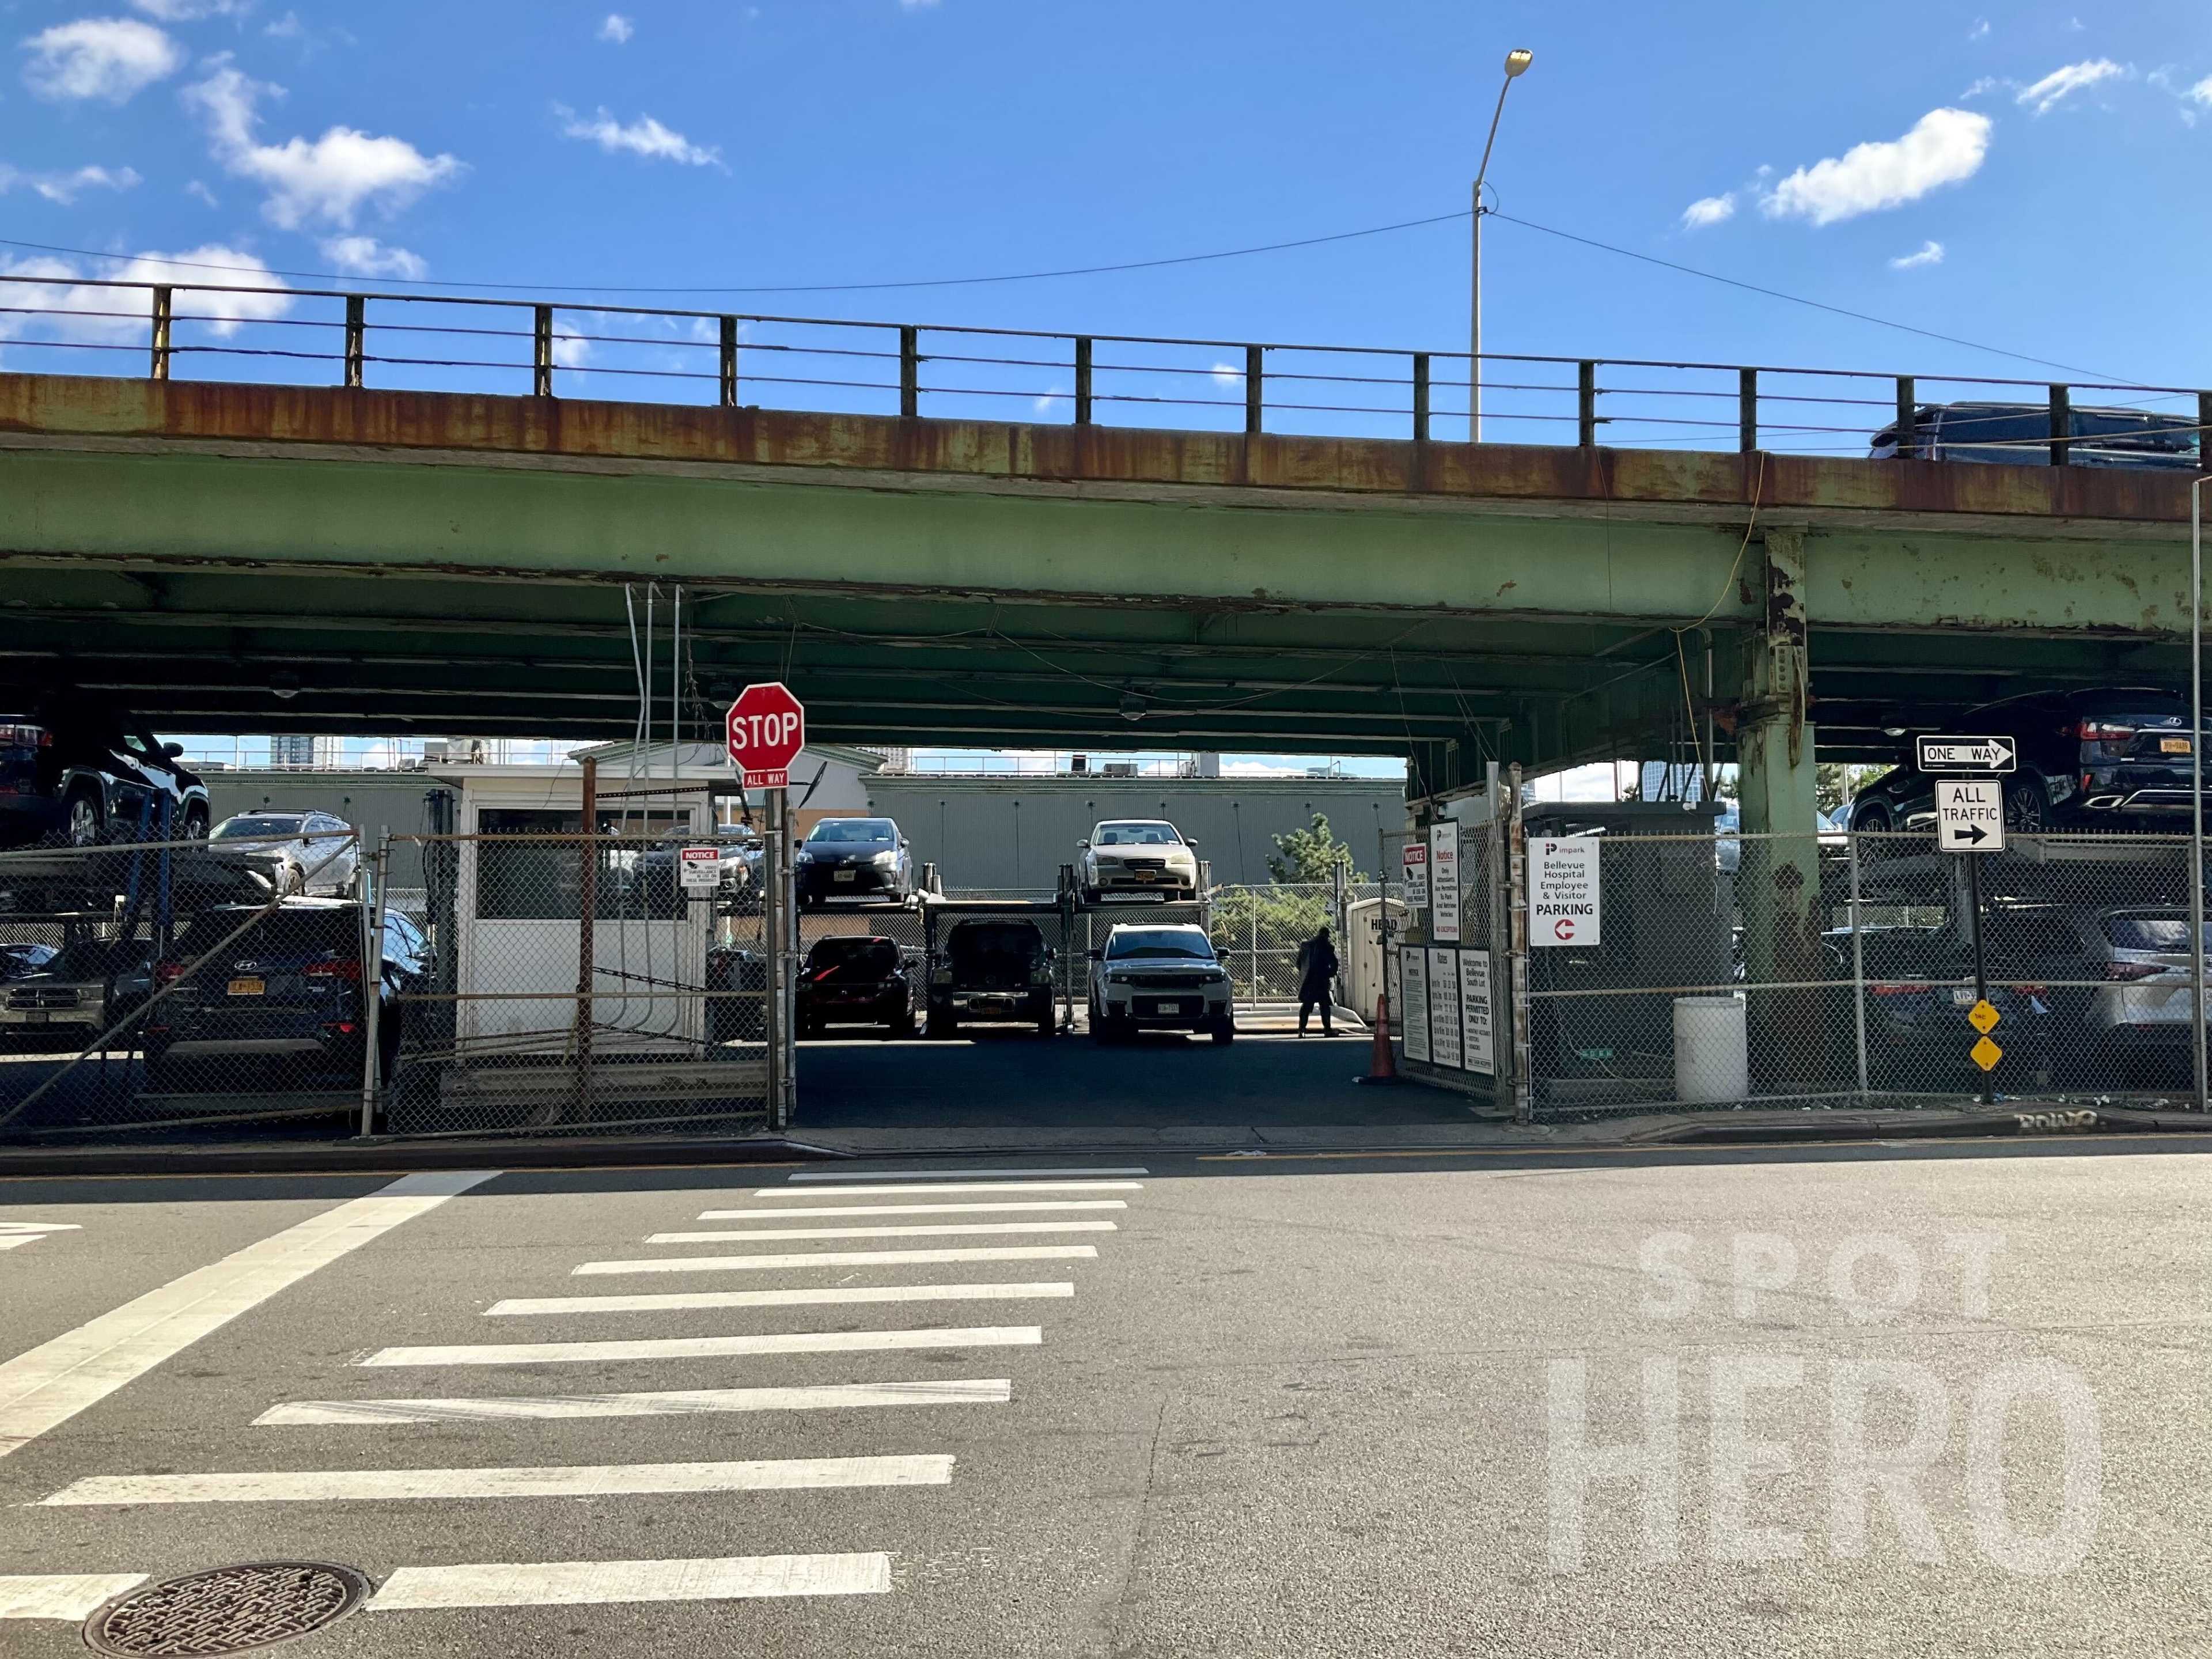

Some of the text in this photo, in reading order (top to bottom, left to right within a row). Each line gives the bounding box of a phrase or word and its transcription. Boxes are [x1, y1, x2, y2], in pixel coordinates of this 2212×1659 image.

[732, 712, 798, 749] STOP
[1927, 748, 2001, 760] ONE WAY
[747, 773, 785, 785] ALL WAY
[1953, 787, 1986, 802] ALL
[1942, 808, 1998, 820] TRAFFIC
[1404, 850, 1423, 862] NOTICE
[1437, 849, 1453, 860] Notice
[1559, 846, 1585, 855] impark
[1544, 861, 1585, 869] Bellevue
[1544, 870, 1585, 880] Hospital
[1540, 881, 1589, 891] Employee
[1554, 891, 1587, 899] Visitor
[1536, 903, 1593, 915] PARKING
[1437, 952, 1448, 964] Rates
[1462, 958, 1488, 968] Welcome to
[1465, 968, 1485, 978] Bellevue
[1467, 979, 1478, 987] South
[1466, 994, 1488, 1005] PARKING
[1465, 1005, 1490, 1015] PERMITTED
[1468, 1014, 1479, 1025] ONLY
